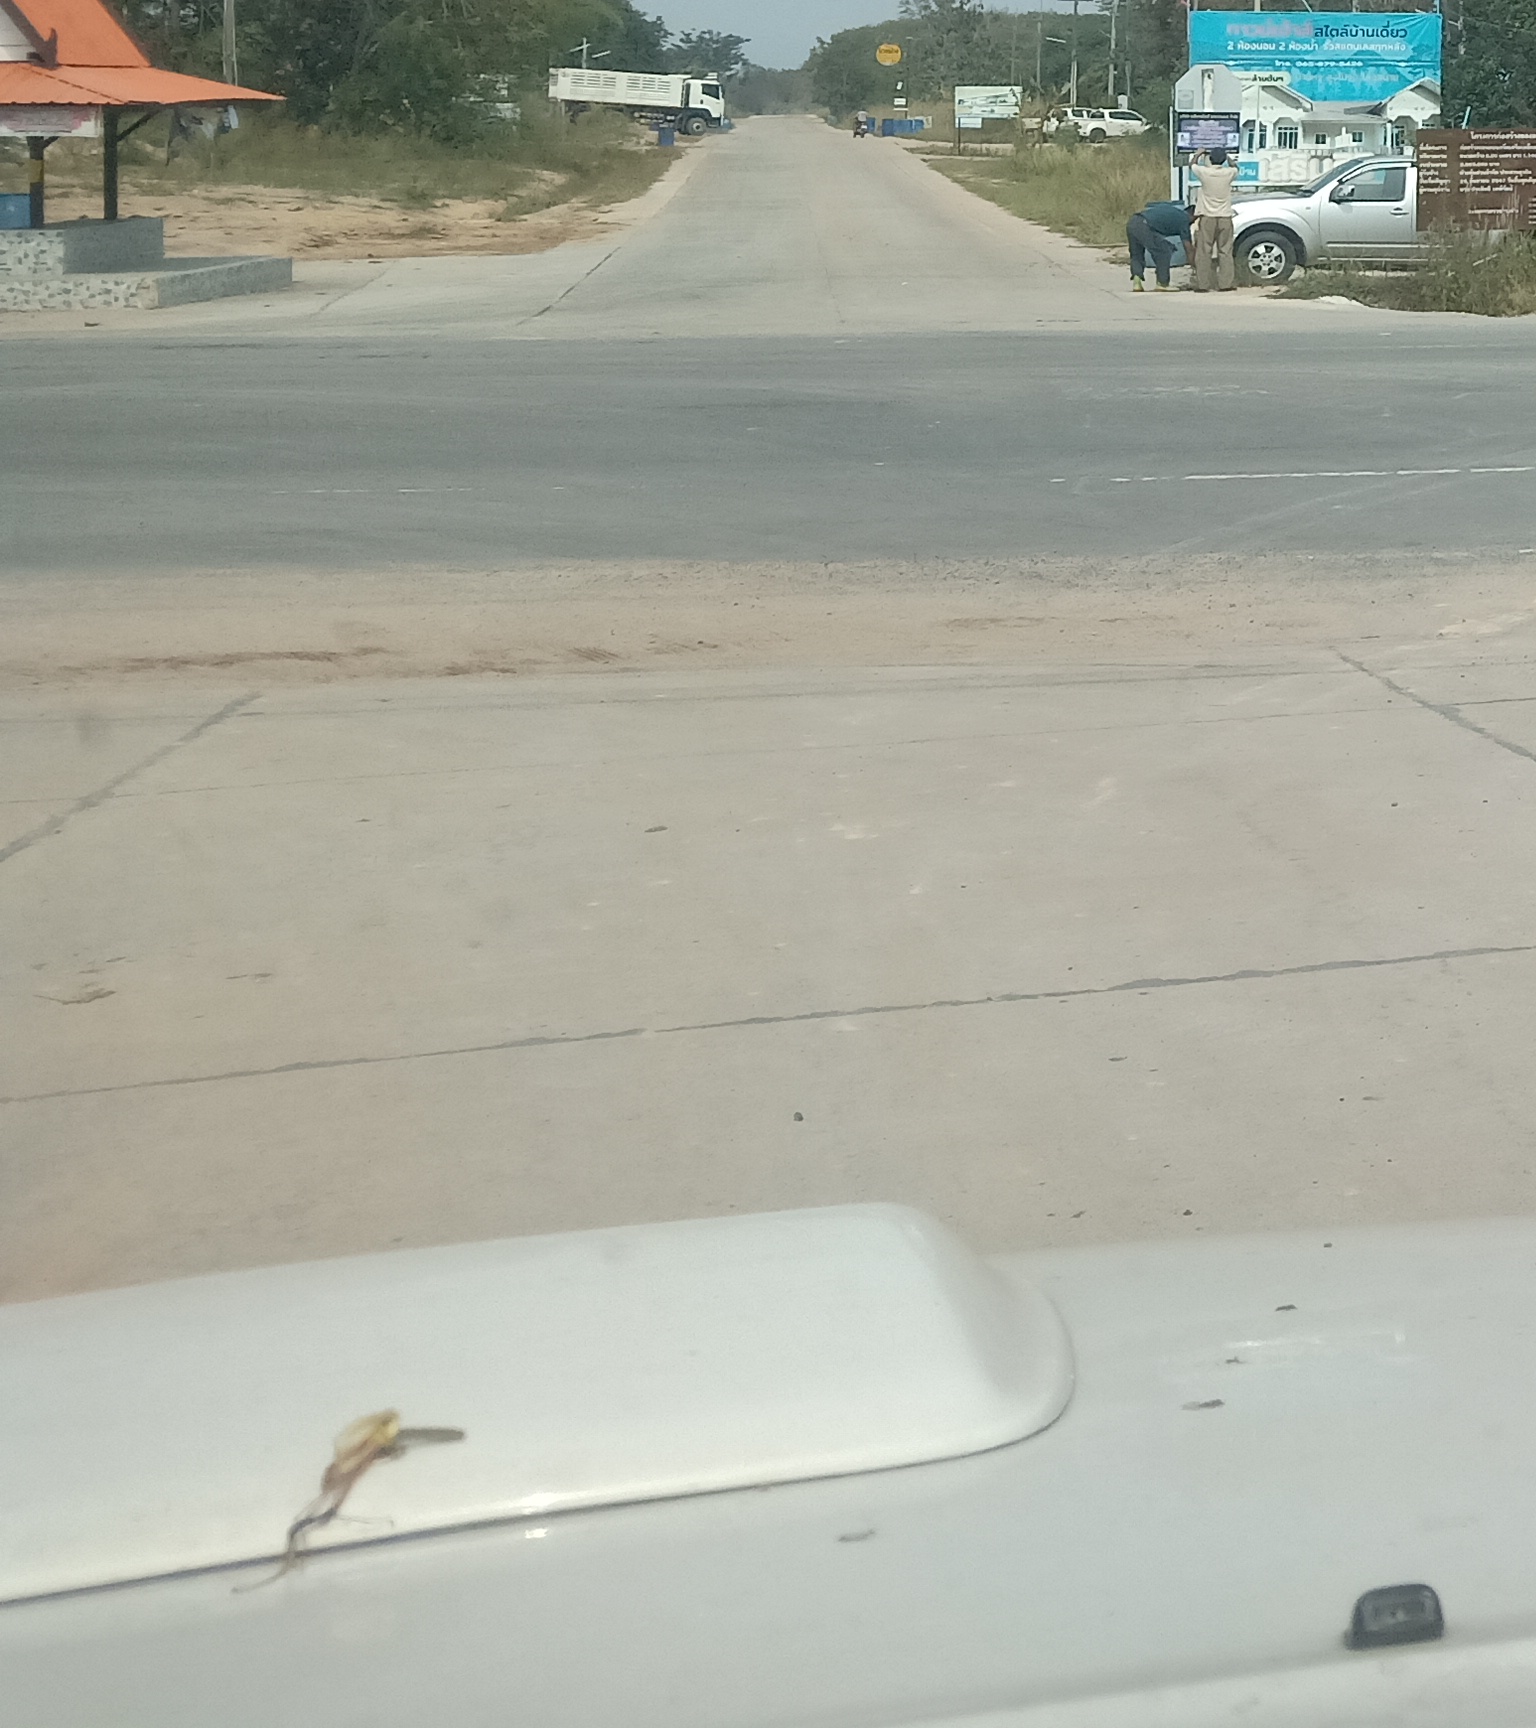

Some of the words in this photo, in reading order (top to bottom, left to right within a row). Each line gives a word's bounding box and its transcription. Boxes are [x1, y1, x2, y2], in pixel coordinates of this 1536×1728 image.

[1227, 41, 1234, 51] 2
[1237, 40, 1276, 51] ห้องนอน
[1278, 41, 1286, 51] 2
[1288, 38, 1319, 51] ห้องน้ำ
